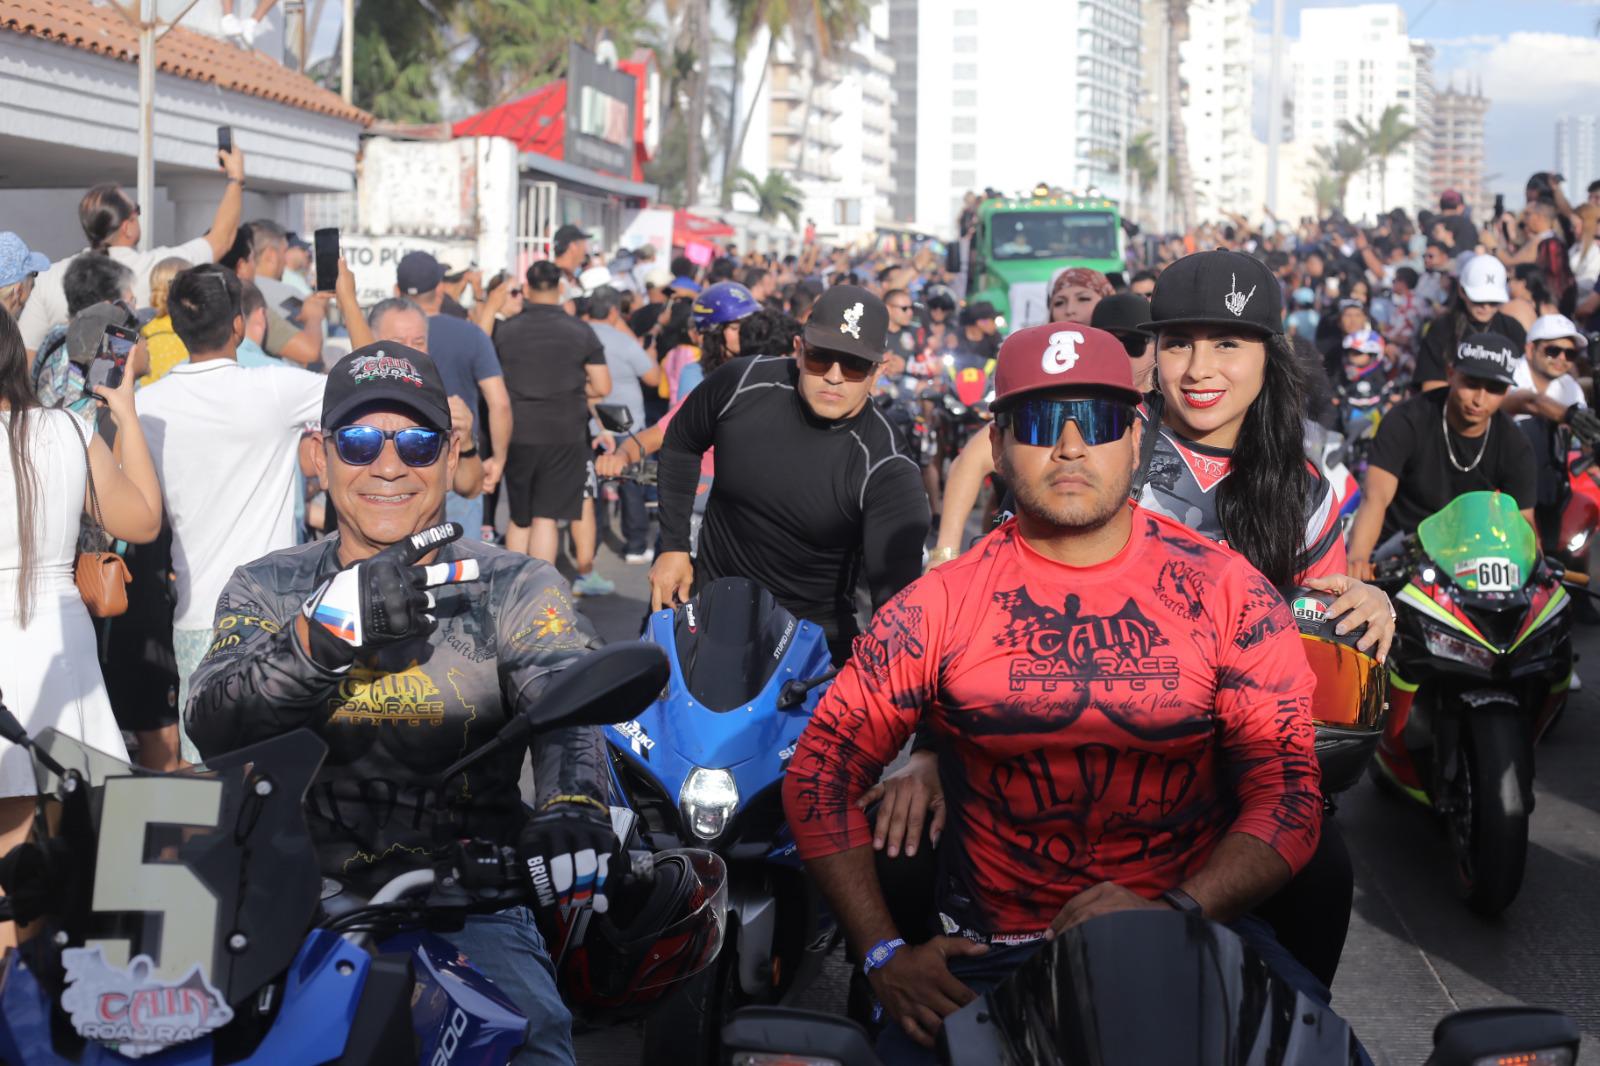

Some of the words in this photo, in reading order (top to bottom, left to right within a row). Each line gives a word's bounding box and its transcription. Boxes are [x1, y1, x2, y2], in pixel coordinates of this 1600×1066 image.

[411, 522, 455, 550] BRUMM
[1479, 562, 1511, 587] 601
[773, 634, 788, 660] STUPID
[784, 619, 794, 638] FAST
[1010, 657, 1090, 676] ROA
[1094, 656, 1180, 675] RACE
[1010, 679, 1180, 692] MEXICO
[385, 700, 445, 716] RACE
[1141, 692, 1184, 713] Vida
[86, 776, 223, 980] 5
[527, 855, 556, 908] BRUMM
